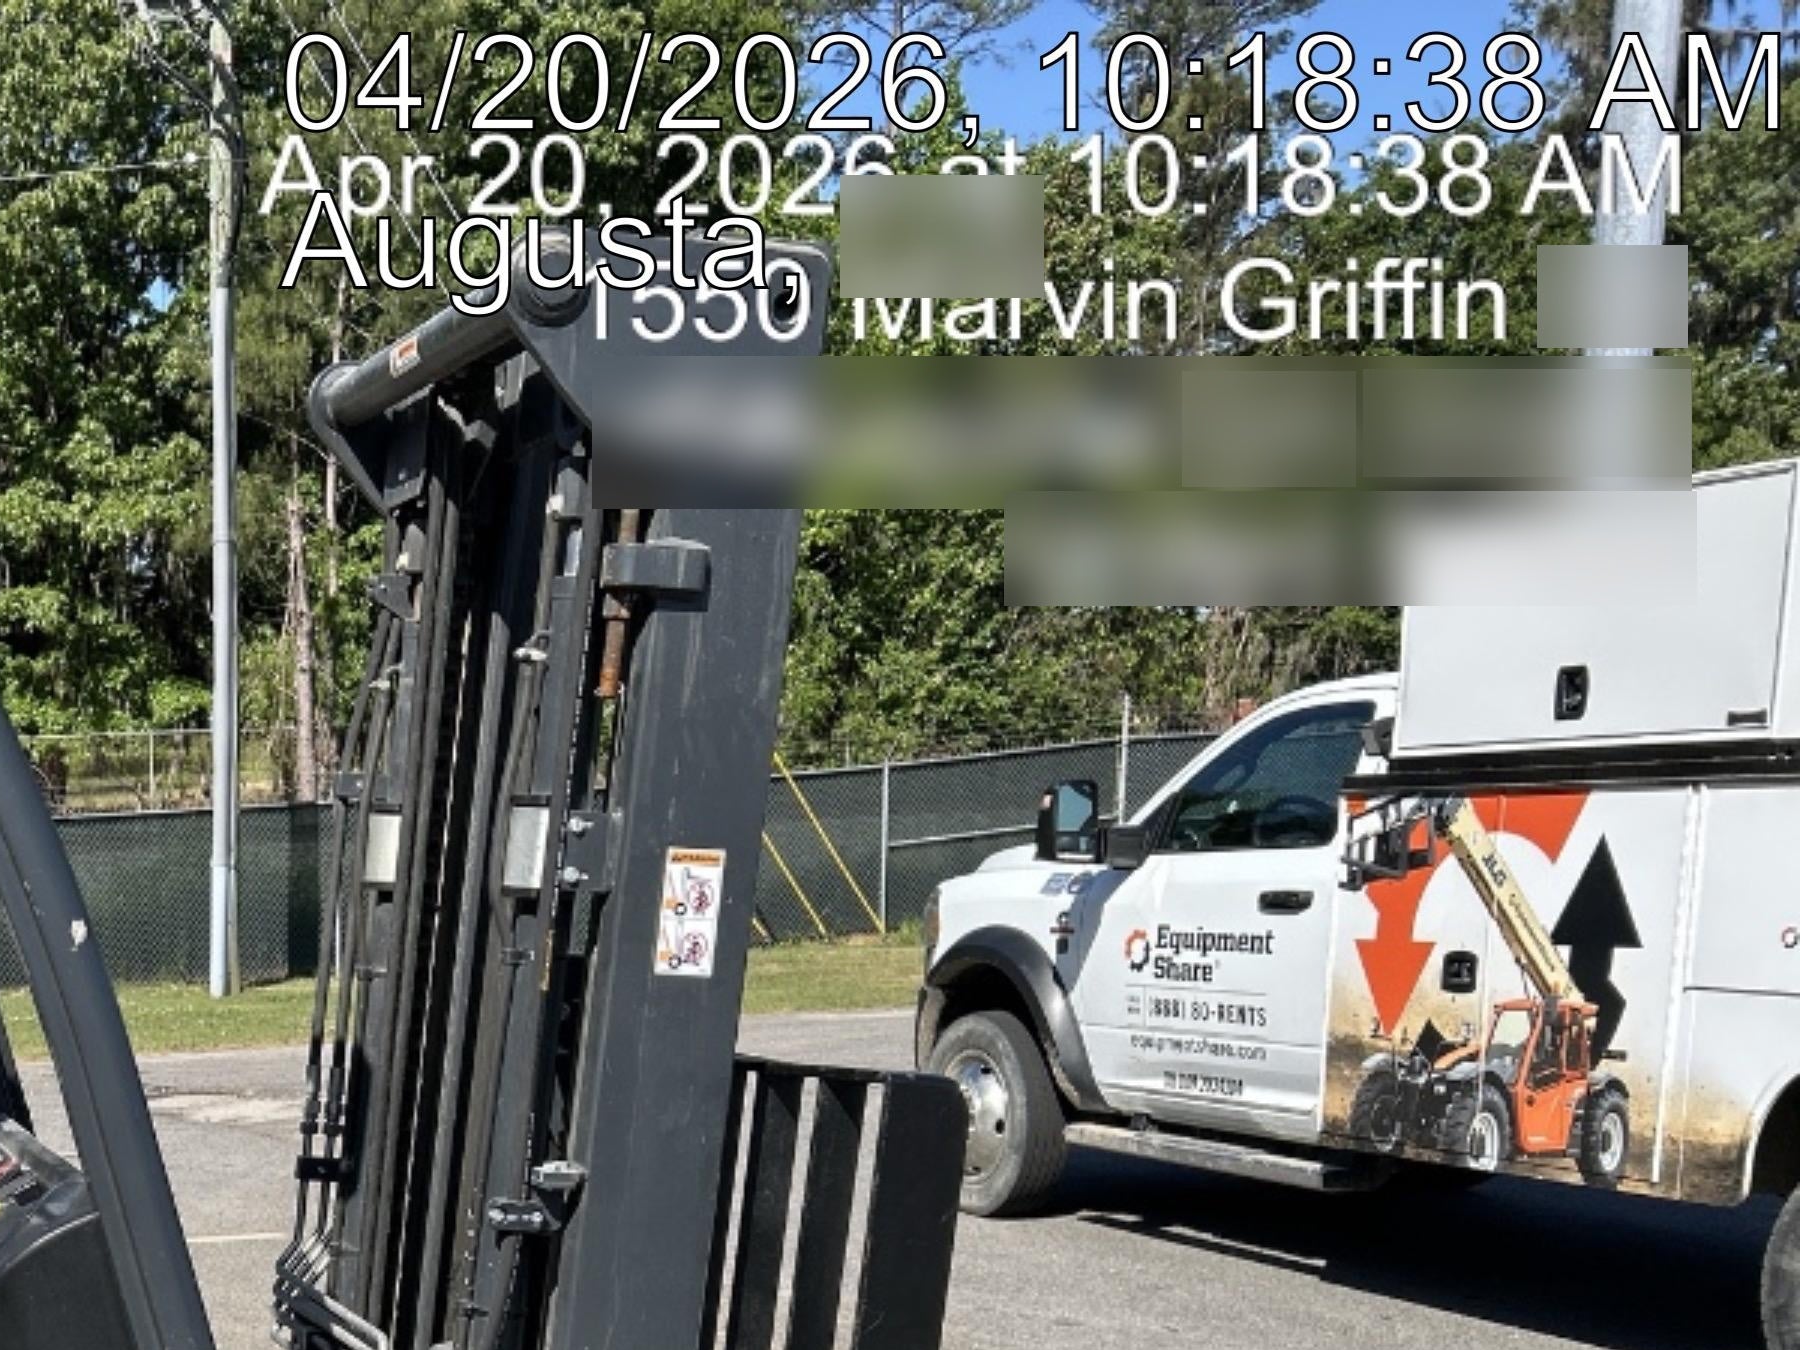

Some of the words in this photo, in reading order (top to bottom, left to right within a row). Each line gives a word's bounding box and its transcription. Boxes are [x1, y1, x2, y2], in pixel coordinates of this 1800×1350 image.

[1154, 923, 1275, 957] Equipment
[1153, 955, 1213, 983] Share
[1191, 1000, 1268, 1028] 80-RENTS
